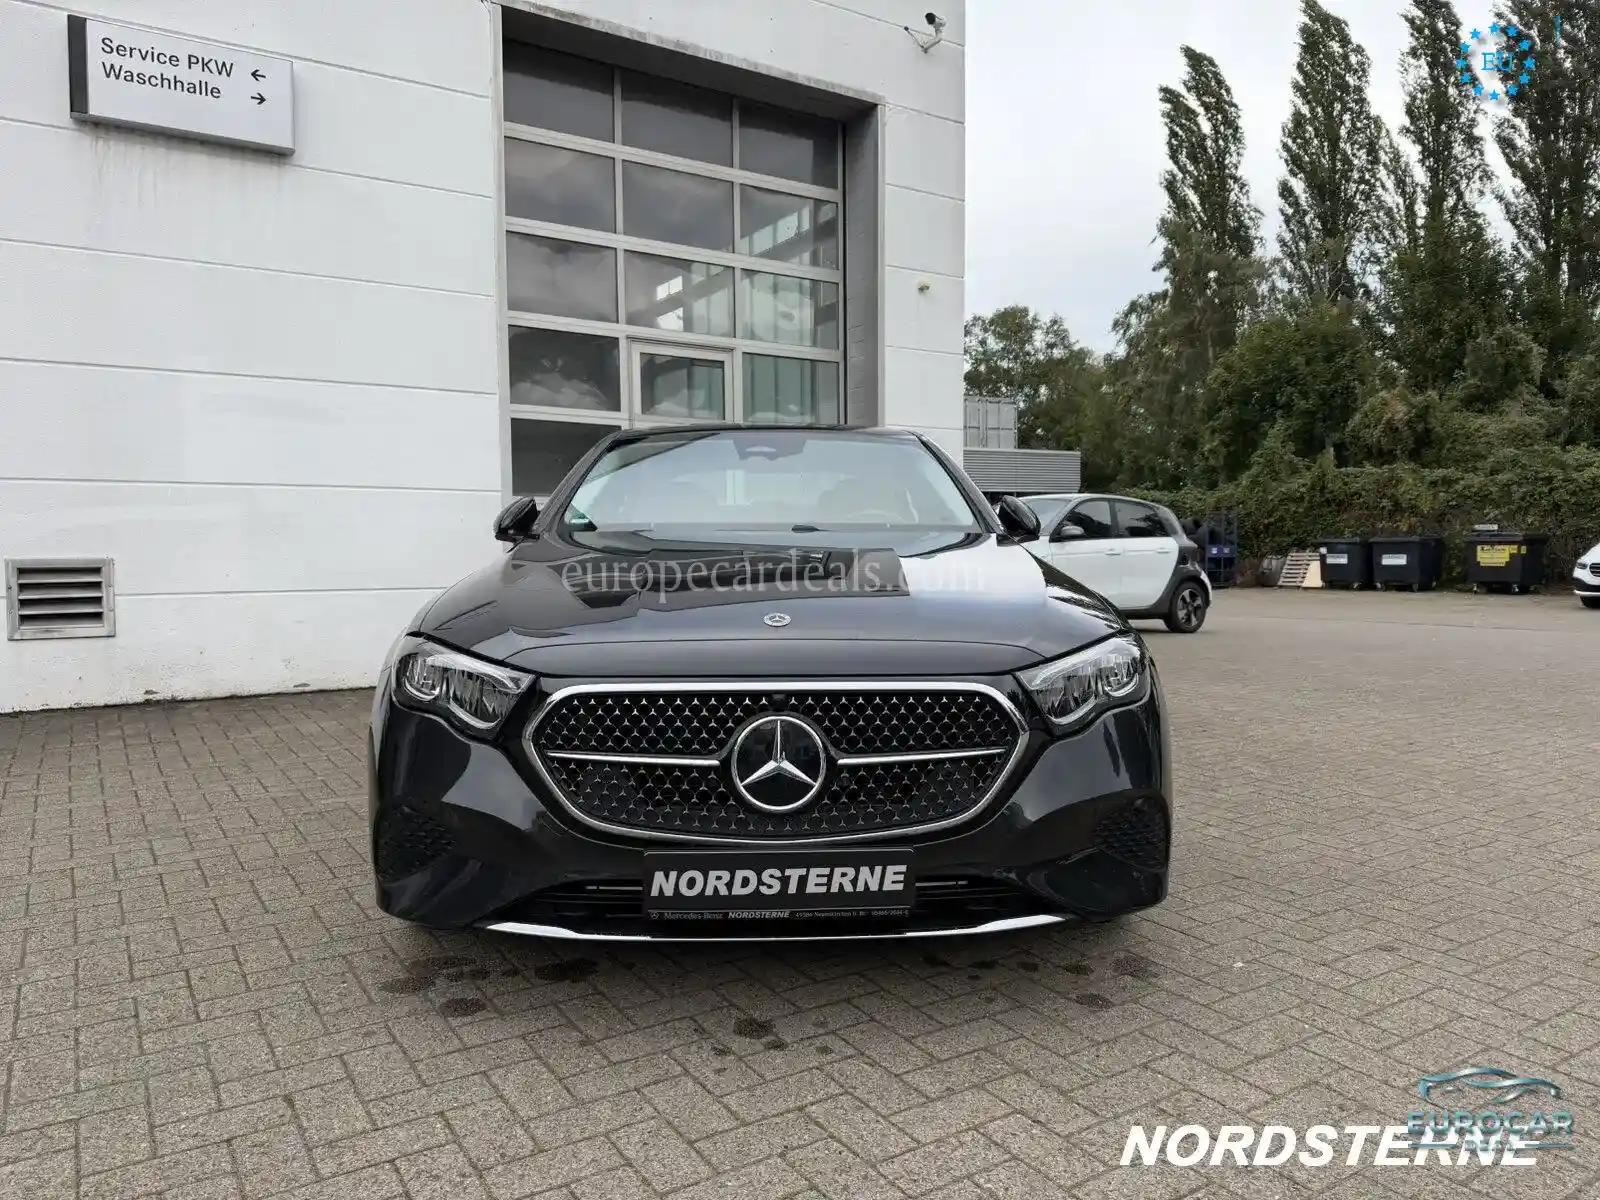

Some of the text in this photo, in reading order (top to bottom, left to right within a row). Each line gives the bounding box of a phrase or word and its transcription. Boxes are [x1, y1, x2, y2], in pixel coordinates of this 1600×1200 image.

[101, 37, 234, 78] Service PKW
[101, 61, 221, 99] Waschhalle
[650, 864, 907, 897] NORDSTERNE
[664, 912, 724, 920] Mercedes-Benz
[728, 911, 790, 919] NORDSTERNE
